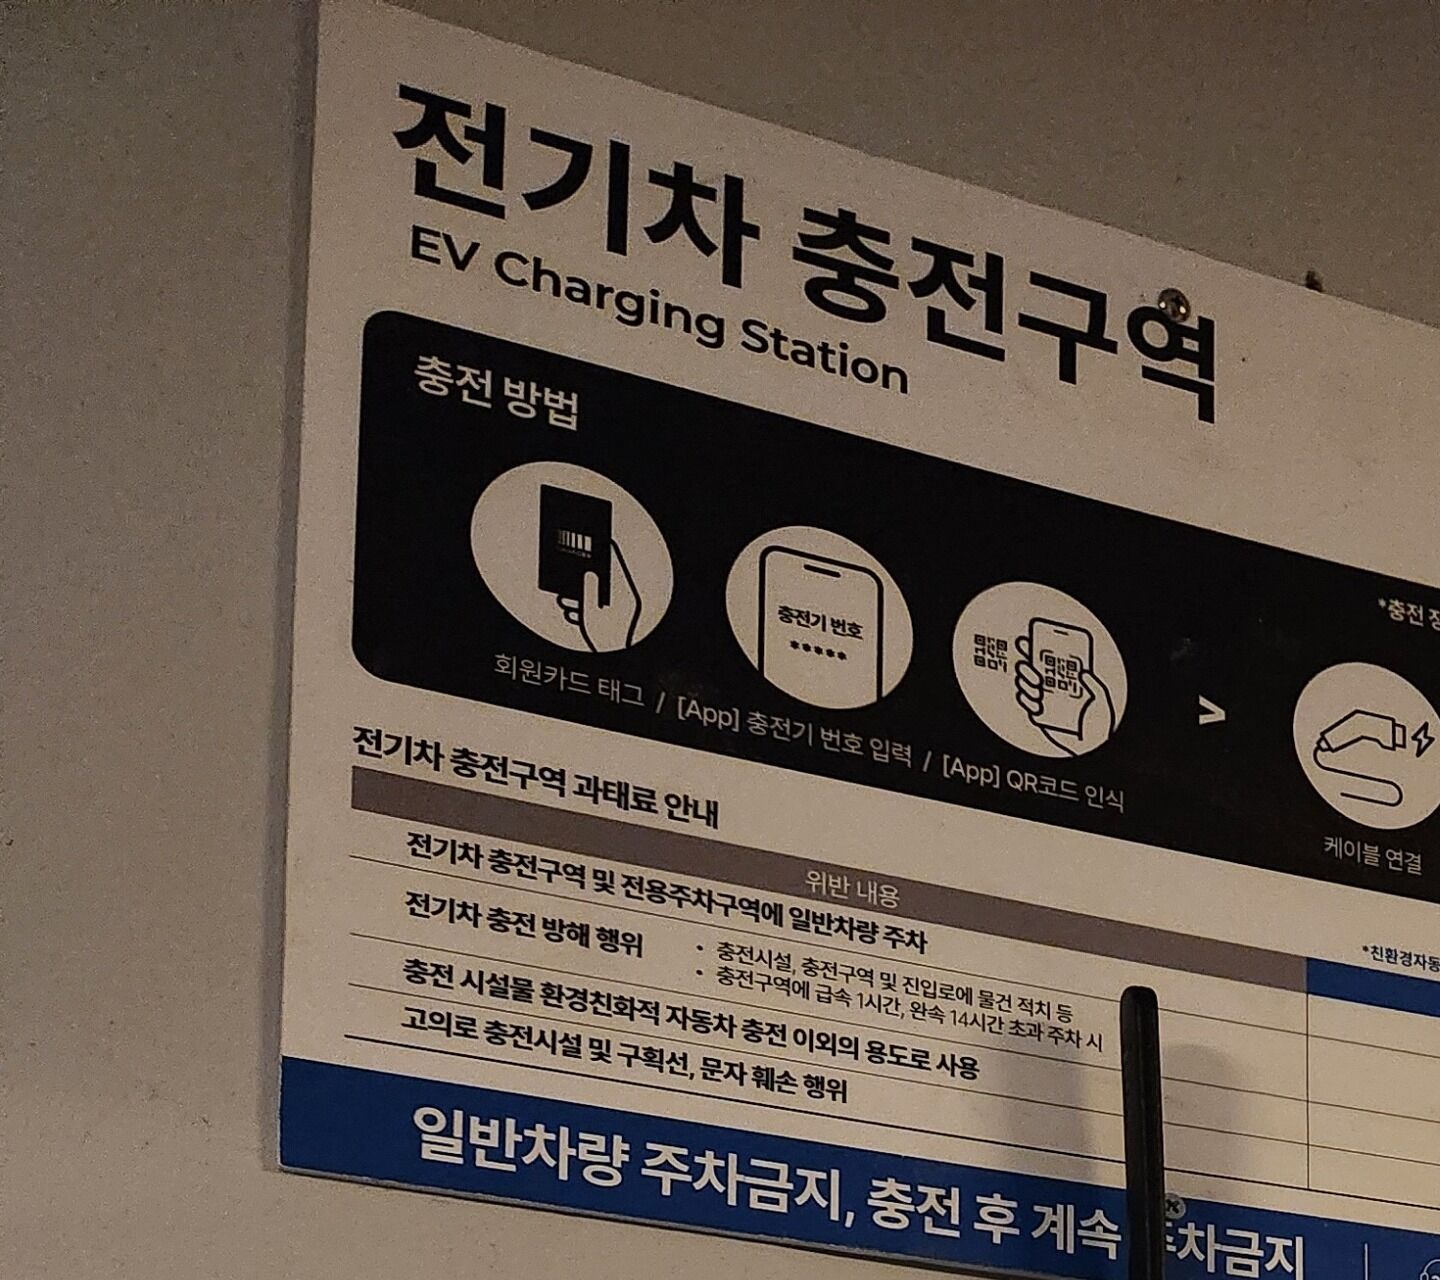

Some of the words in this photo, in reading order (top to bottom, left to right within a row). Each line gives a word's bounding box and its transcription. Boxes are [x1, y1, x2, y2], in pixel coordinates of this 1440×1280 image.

[392, 82, 761, 290] 전기차
[790, 207, 1216, 424] 충전구역
[411, 224, 481, 272] EV
[494, 249, 725, 350] Charging
[742, 319, 909, 395] Station
[413, 354, 493, 410] 충전
[503, 374, 580, 432] 방법
[776, 604, 828, 634] 충전기
[829, 610, 863, 639] 번호
[353, 725, 445, 772] 전기차
[450, 747, 566, 798] 충전구역
[573, 773, 659, 814] 과태료
[663, 792, 720, 829] 안내
[493, 651, 593, 696] 회원카드
[598, 676, 645, 708] 태그
[677, 694, 741, 732] [App]
[748, 711, 815, 748] 충전기
[820, 726, 865, 758] 번호
[871, 737, 912, 768] 입력
[942, 754, 1001, 789] [App]
[1006, 768, 1080, 802] QR코드
[1085, 782, 1126, 814] 인식
[406, 832, 484, 870] 전기차
[488, 848, 587, 889] 충전구역
[592, 869, 615, 896] 및
[621, 873, 784, 928] 전용주차구역에
[789, 906, 879, 946] 일반차량
[883, 924, 928, 955] 주차
[805, 870, 851, 900] 위반
[856, 878, 900, 909] 내용
[1324, 836, 1382, 869] 케이블
[1386, 842, 1423, 876] 연결
[405, 890, 482, 929] 전기차
[486, 907, 536, 938] 충전
[541, 918, 590, 949] 방해
[596, 927, 644, 958] 행위
[402, 957, 455, 990] 충전
[459, 969, 535, 1003] 시설물
[539, 980, 660, 1026] 환경친화적
[665, 1004, 737, 1039] 자동차
[741, 1014, 788, 1048] 충전
[793, 1023, 860, 1061] 이외의
[864, 1039, 931, 1073] 용도로
[935, 1052, 980, 1082] 사용
[716, 966, 810, 1000] 충전구역에
[815, 984, 852, 1008] 급속
[857, 992, 905, 1020] 1시간,
[909, 1000, 945, 1023] 완속
[950, 1008, 1005, 1036] 14시간
[1008, 1019, 1044, 1043] 초과
[1047, 1026, 1082, 1050] 주차
[1086, 1032, 1104, 1054] 시
[717, 941, 796, 975] 충전시설,
[801, 957, 875, 989] 충전구역
[879, 972, 897, 992] 및
[902, 975, 973, 1005] 진입로에
[977, 990, 1012, 1012] 물건
[1017, 997, 1051, 1020] 적치
[1057, 1004, 1074, 1023] 등
[400, 1006, 480, 1039] 고의로
[483, 1019, 584, 1060] 충전시설
[588, 1036, 612, 1064] 및
[617, 1041, 694, 1080] 구획선,
[700, 1055, 748, 1087] 문자
[751, 1065, 799, 1096] 훼손
[802, 1072, 849, 1105] 행위
[412, 1103, 631, 1188] 일반차량
[641, 1138, 856, 1230] 주차금지,
[867, 1177, 960, 1240] 충전
[973, 1191, 1021, 1245] 후
[1031, 1202, 1123, 1261] 계속
